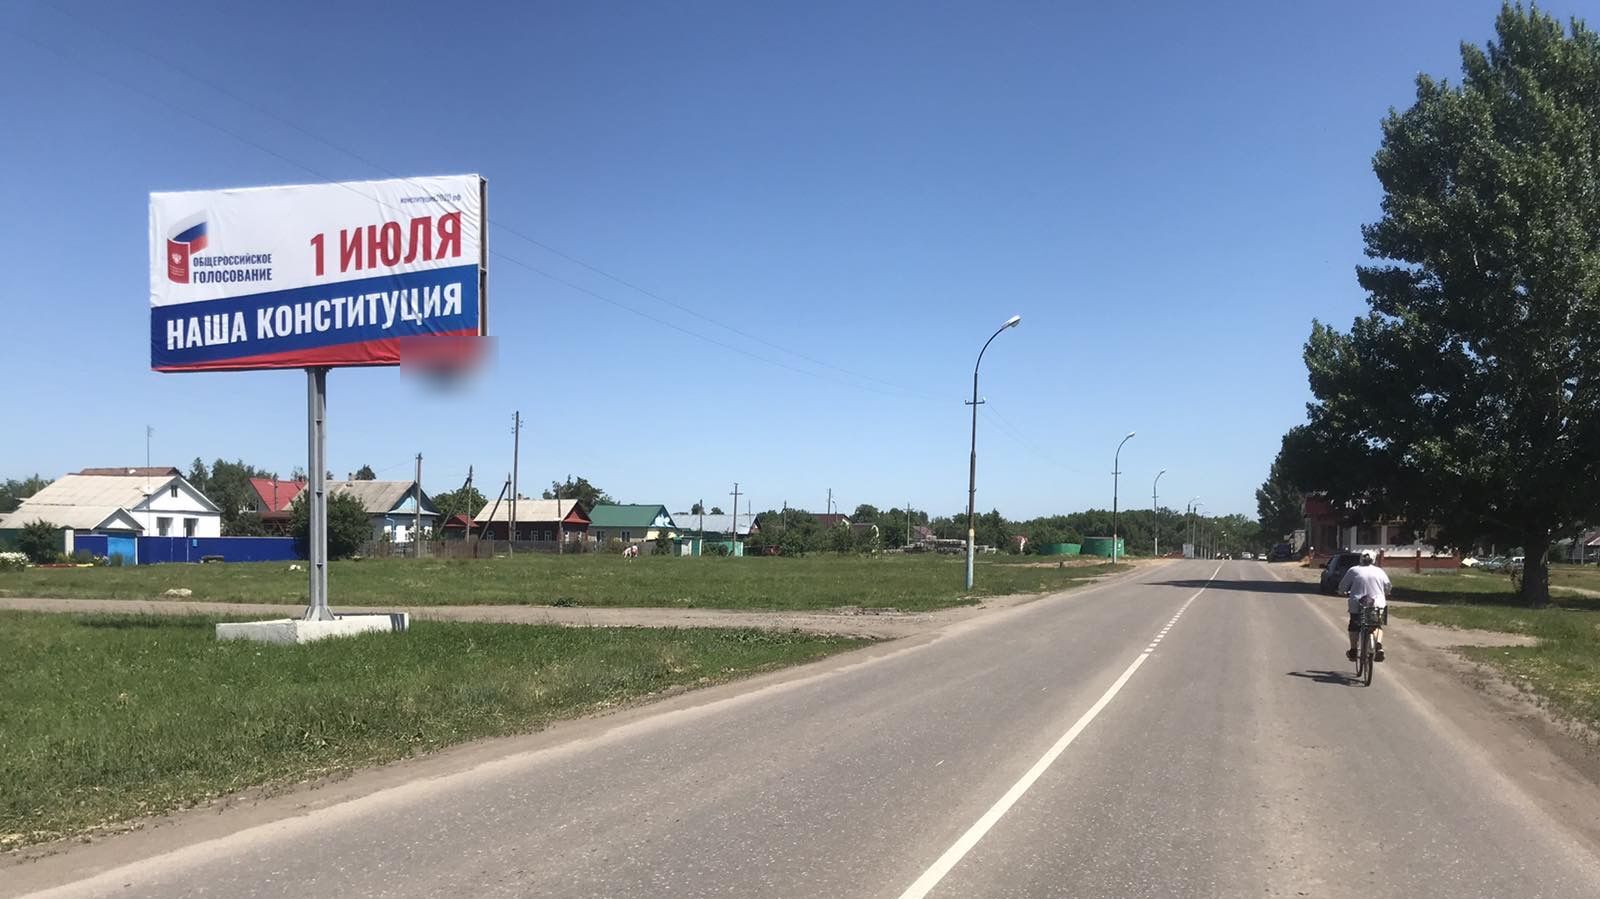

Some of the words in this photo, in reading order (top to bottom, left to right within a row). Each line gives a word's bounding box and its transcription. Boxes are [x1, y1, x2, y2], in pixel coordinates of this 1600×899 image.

[193, 252, 272, 268] ОБЩЕРОССИЙСКОЕ
[310, 233, 325, 276] 1
[340, 212, 462, 273] ИЮЛЯ
[193, 268, 272, 284] ГОЛОСОВАНИЕ
[167, 311, 248, 351] НАША
[257, 282, 462, 340] КОНСТИТУЦИЯ
